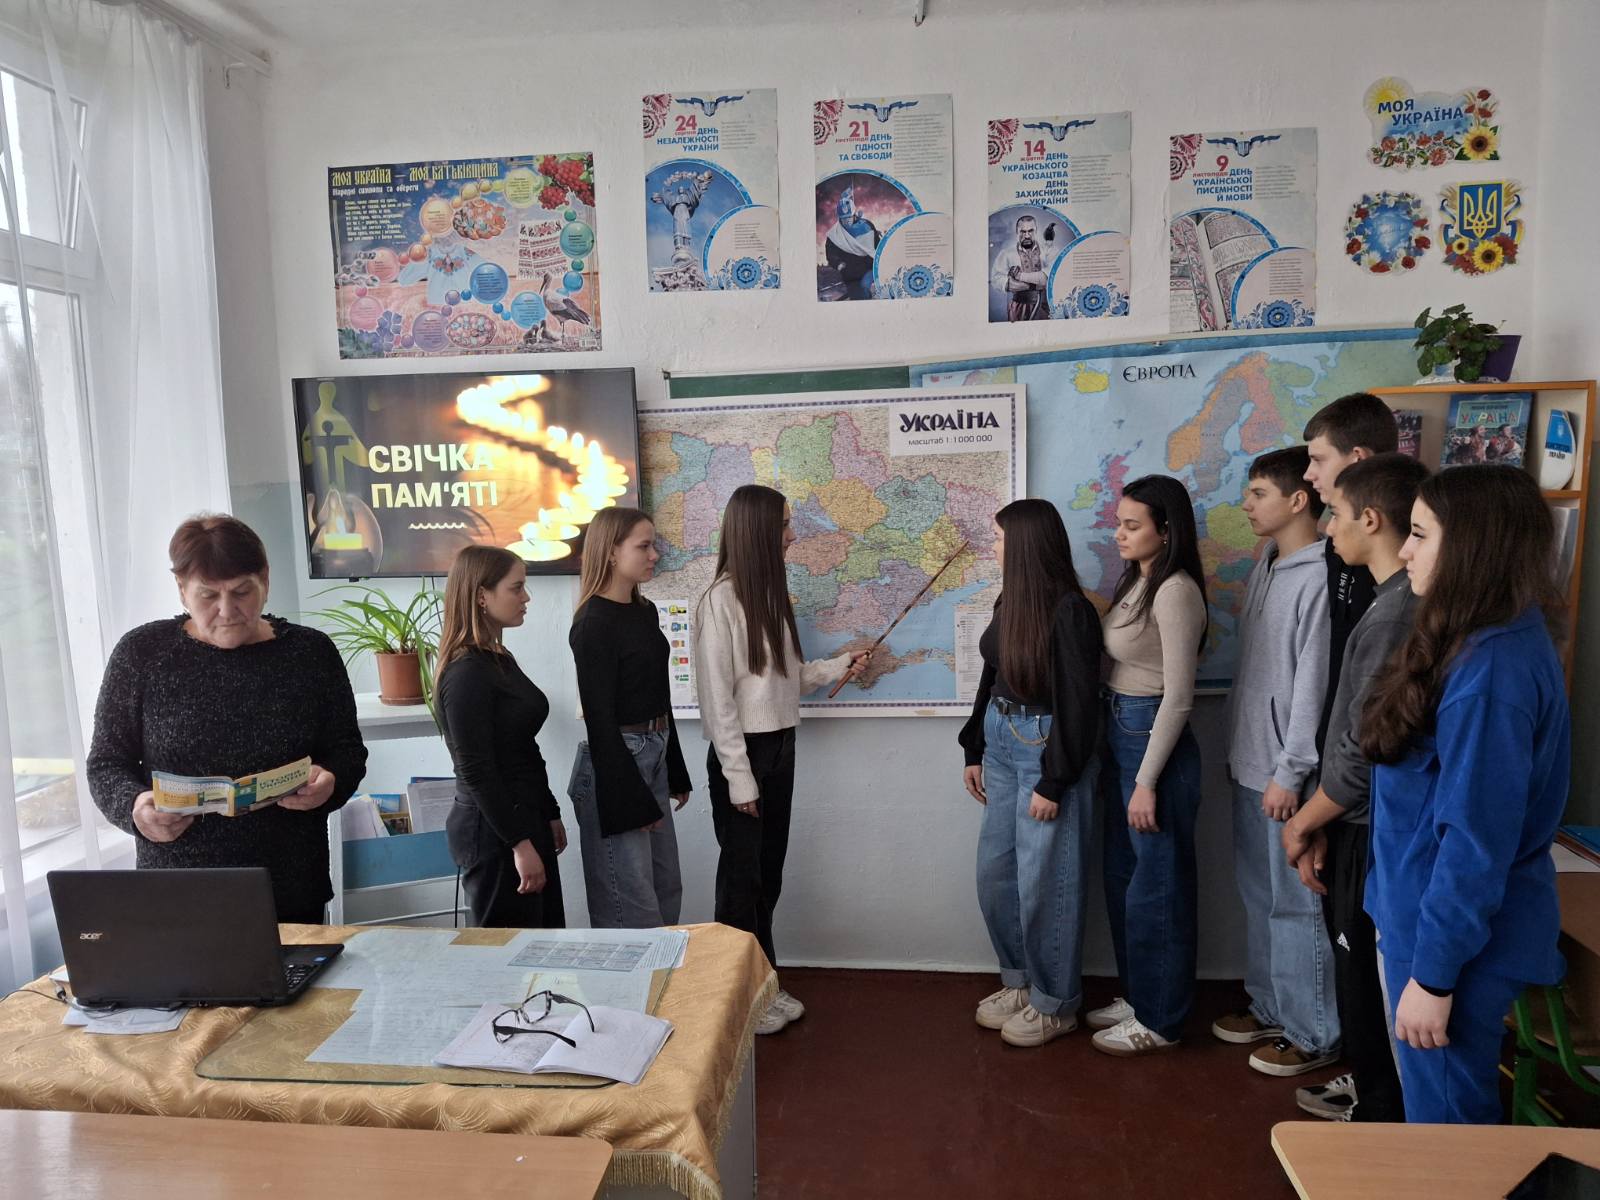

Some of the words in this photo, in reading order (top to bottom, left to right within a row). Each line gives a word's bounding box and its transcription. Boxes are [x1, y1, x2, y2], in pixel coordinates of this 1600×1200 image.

[1377, 98, 1414, 114] МОЯ
[1392, 106, 1464, 126] УКРАЇНА
[675, 114, 697, 132] 24
[849, 120, 869, 138] 21
[656, 136, 718, 144] НЕЗАЛЕЖНОСТІ
[870, 134, 892, 142] ДЕНЬ
[855, 142, 892, 152] ГІДНОСТІ
[1024, 140, 1046, 156] 14
[851, 152, 892, 160] СВОБОДИ
[1046, 152, 1068, 160] ДЕНЬ
[1002, 162, 1068, 172] УКРАЇНСЬКОГО
[1216, 155, 1229, 172] 9
[332, 170, 352, 186] МОЯ
[354, 167, 392, 184] УКРАЇНА
[409, 166, 429, 182] МОЯ
[1022, 171, 1068, 180] КОЗАЦТВА
[1230, 168, 1252, 176] ДЕНЬ
[1046, 180, 1068, 188] ДЕНЬ
[1016, 190, 1068, 198] ЗАХИСНИКА
[1196, 185, 1252, 195] ПИСЕМНОСТІ
[1226, 193, 1252, 202] МОВИ
[1122, 364, 1196, 382] ЄВРОПА
[900, 409, 1000, 432] УКРАЇНА
[908, 438, 944, 446] масштаб
[368, 444, 494, 473] СВІЧКА
[80, 932, 103, 940] acer
